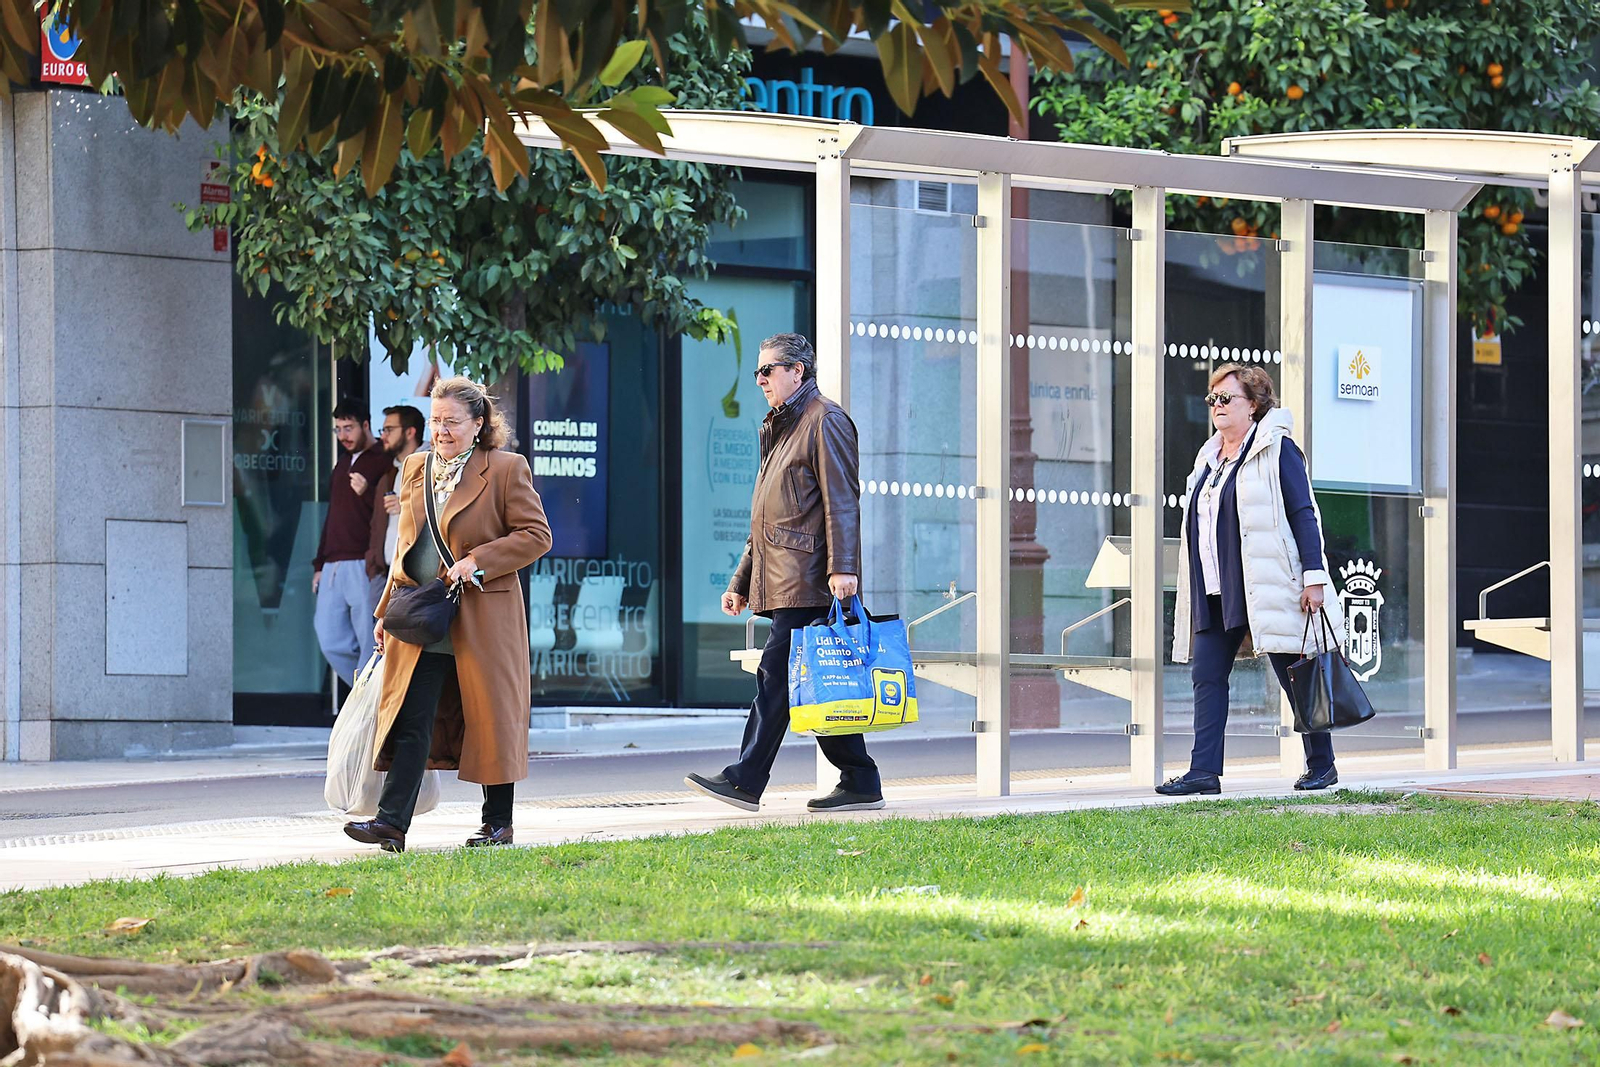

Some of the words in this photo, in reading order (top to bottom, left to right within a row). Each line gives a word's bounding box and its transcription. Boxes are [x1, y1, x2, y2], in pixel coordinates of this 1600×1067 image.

[43, 63, 74, 76] EURO
[1340, 383, 1379, 397] semoan
[533, 418, 578, 437] CONFÍA
[580, 421, 598, 437] EN
[533, 438, 552, 451] LAS
[553, 439, 597, 453] MEJORES
[725, 442, 753, 457] MIEDO
[533, 456, 597, 478] MANOS
[713, 471, 730, 484] CON
[733, 472, 753, 485] ELLA
[815, 636, 833, 646] Lidl
[816, 647, 851, 657] Quanto
[818, 657, 840, 666] mais
